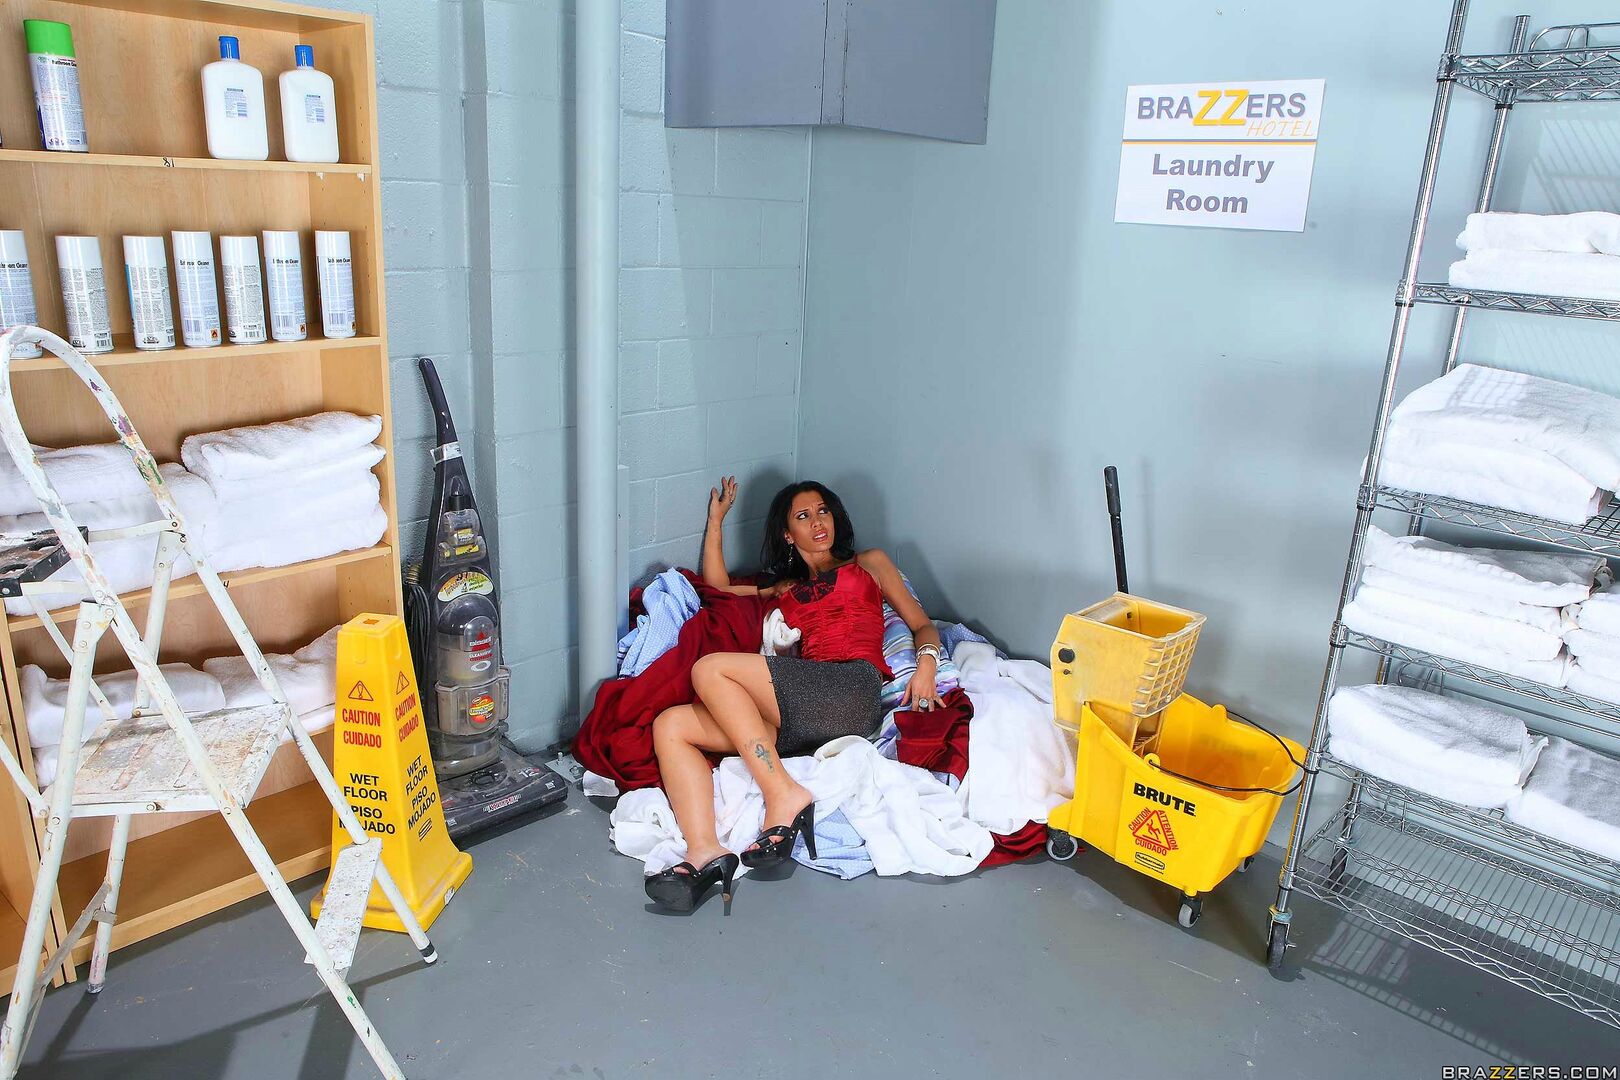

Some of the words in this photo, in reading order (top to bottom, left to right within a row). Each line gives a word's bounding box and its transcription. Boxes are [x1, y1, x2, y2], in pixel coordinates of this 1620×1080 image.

[1137, 89, 1306, 126] BRAZZERS
[1246, 120, 1315, 137] HOTEL
[1152, 153, 1275, 184] Laundry
[1166, 188, 1249, 213] Room
[342, 708, 381, 726] CAUTION
[395, 693, 417, 721] CAUTION
[343, 730, 382, 748] CUIDADO
[398, 714, 420, 742] CUIDADO
[406, 755, 422, 778] WET
[350, 773, 379, 786] WET
[405, 765, 429, 796] FLOOR
[343, 786, 388, 801] FLOOR
[412, 786, 428, 810] PISO
[1133, 782, 1196, 817] BRUTE
[351, 805, 382, 818] PISO
[408, 792, 436, 830] MOJADO
[1128, 807, 1151, 831] CAUTION
[339, 818, 395, 834] JADO
[1158, 810, 1179, 850] ATTENTION
[1135, 838, 1167, 856] CUIDADO
